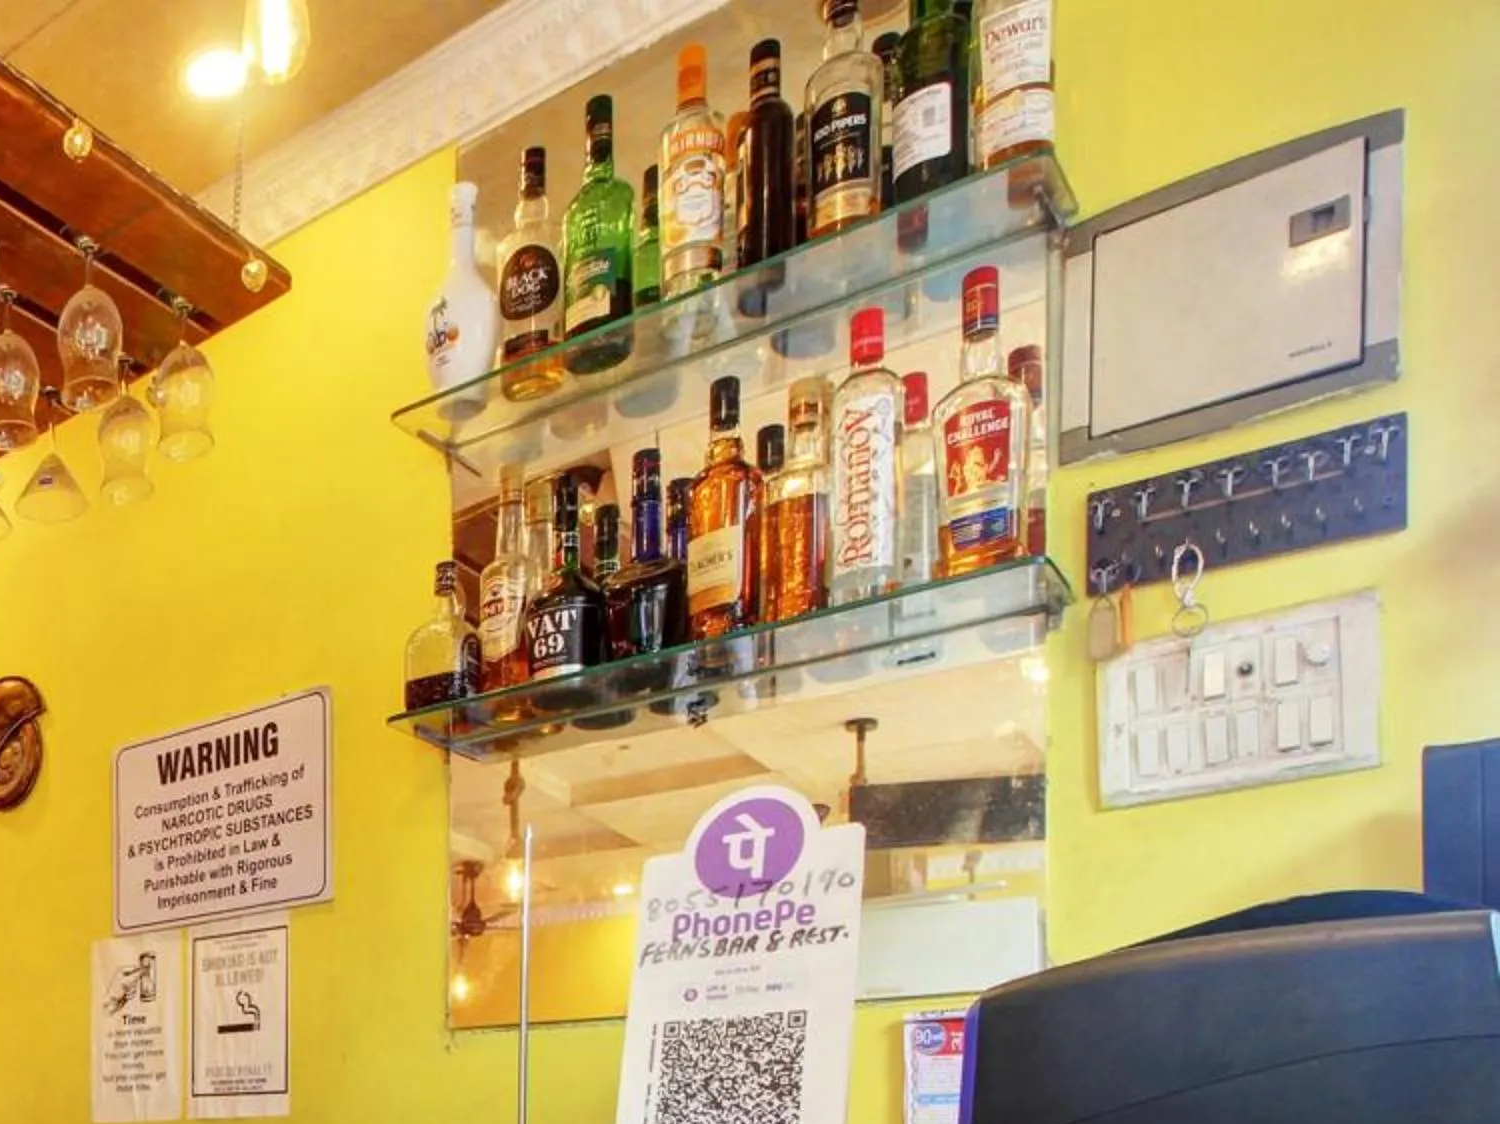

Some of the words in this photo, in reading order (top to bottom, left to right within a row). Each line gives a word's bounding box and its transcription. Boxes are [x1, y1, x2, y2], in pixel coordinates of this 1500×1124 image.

[505, 267, 549, 291] BLACK
[511, 280, 541, 299] DOG
[948, 416, 1009, 445] CHALLENGE
[959, 408, 996, 430] ROYAL
[527, 609, 578, 639] VAT
[533, 633, 565, 659] 69
[157, 722, 279, 785] WARNING
[134, 791, 209, 820] Consumption
[212, 787, 220, 800] &
[225, 771, 288, 796] Trafficking
[292, 764, 305, 780] of
[161, 806, 223, 832] NARCOTIC
[227, 793, 273, 817] DRUGS
[127, 848, 136, 859] &
[138, 824, 223, 856] PSYCHTROPIC
[226, 804, 313, 837] SUBSTANCES
[154, 858, 164, 871] is
[168, 844, 225, 868] Prohibited
[229, 843, 240, 855] in
[243, 837, 268, 854] Law
[272, 833, 281, 847] &
[144, 871, 205, 894] Punishable
[210, 863, 232, 879] with
[237, 852, 293, 876] Rigorous
[158, 884, 234, 910] Imprisonment
[240, 880, 248, 895] &
[251, 876, 278, 892] Fine
[672, 899, 816, 943] PhonePe
[714, 936, 759, 957] BAR
[766, 928, 784, 952] &
